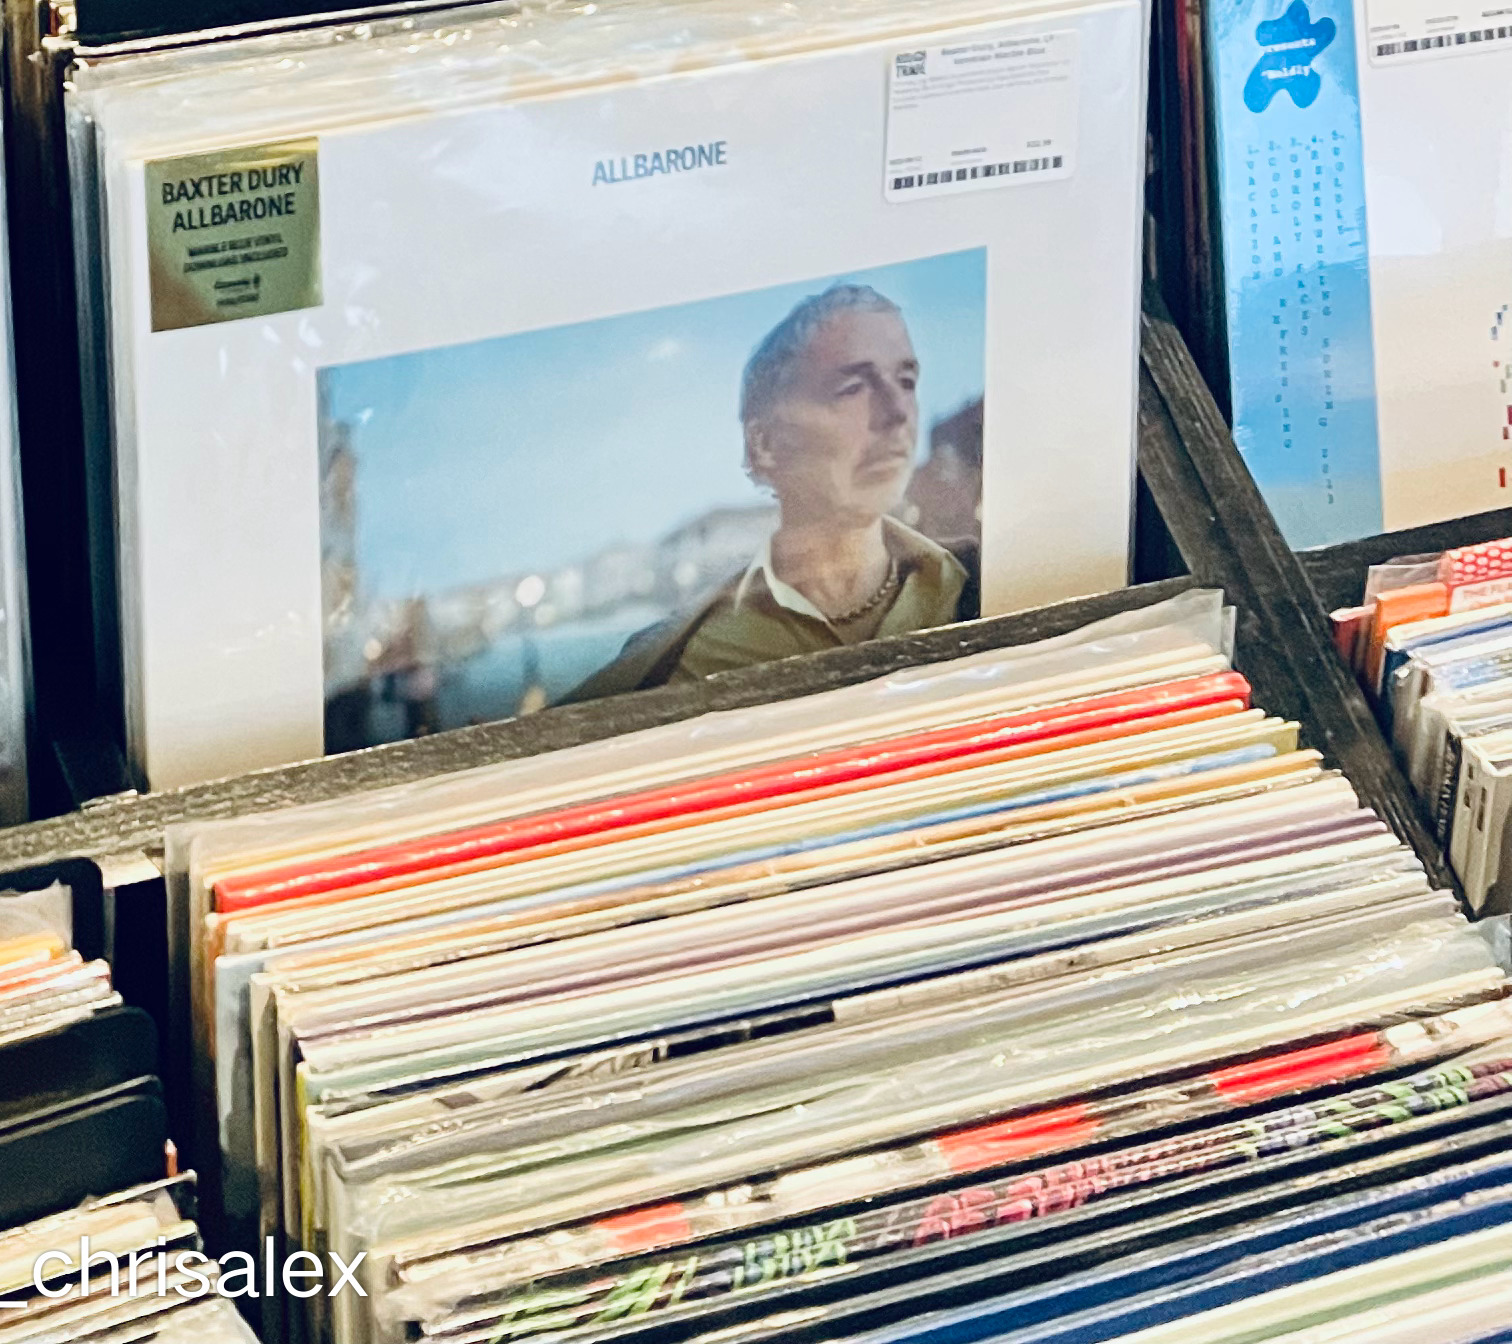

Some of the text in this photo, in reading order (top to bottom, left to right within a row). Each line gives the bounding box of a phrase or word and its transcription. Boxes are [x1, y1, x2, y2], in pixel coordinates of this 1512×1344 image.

[162, 160, 306, 206] BAXTER DURY
[592, 140, 728, 188] ALLBARONE
[172, 191, 296, 234] ALLBARONE
